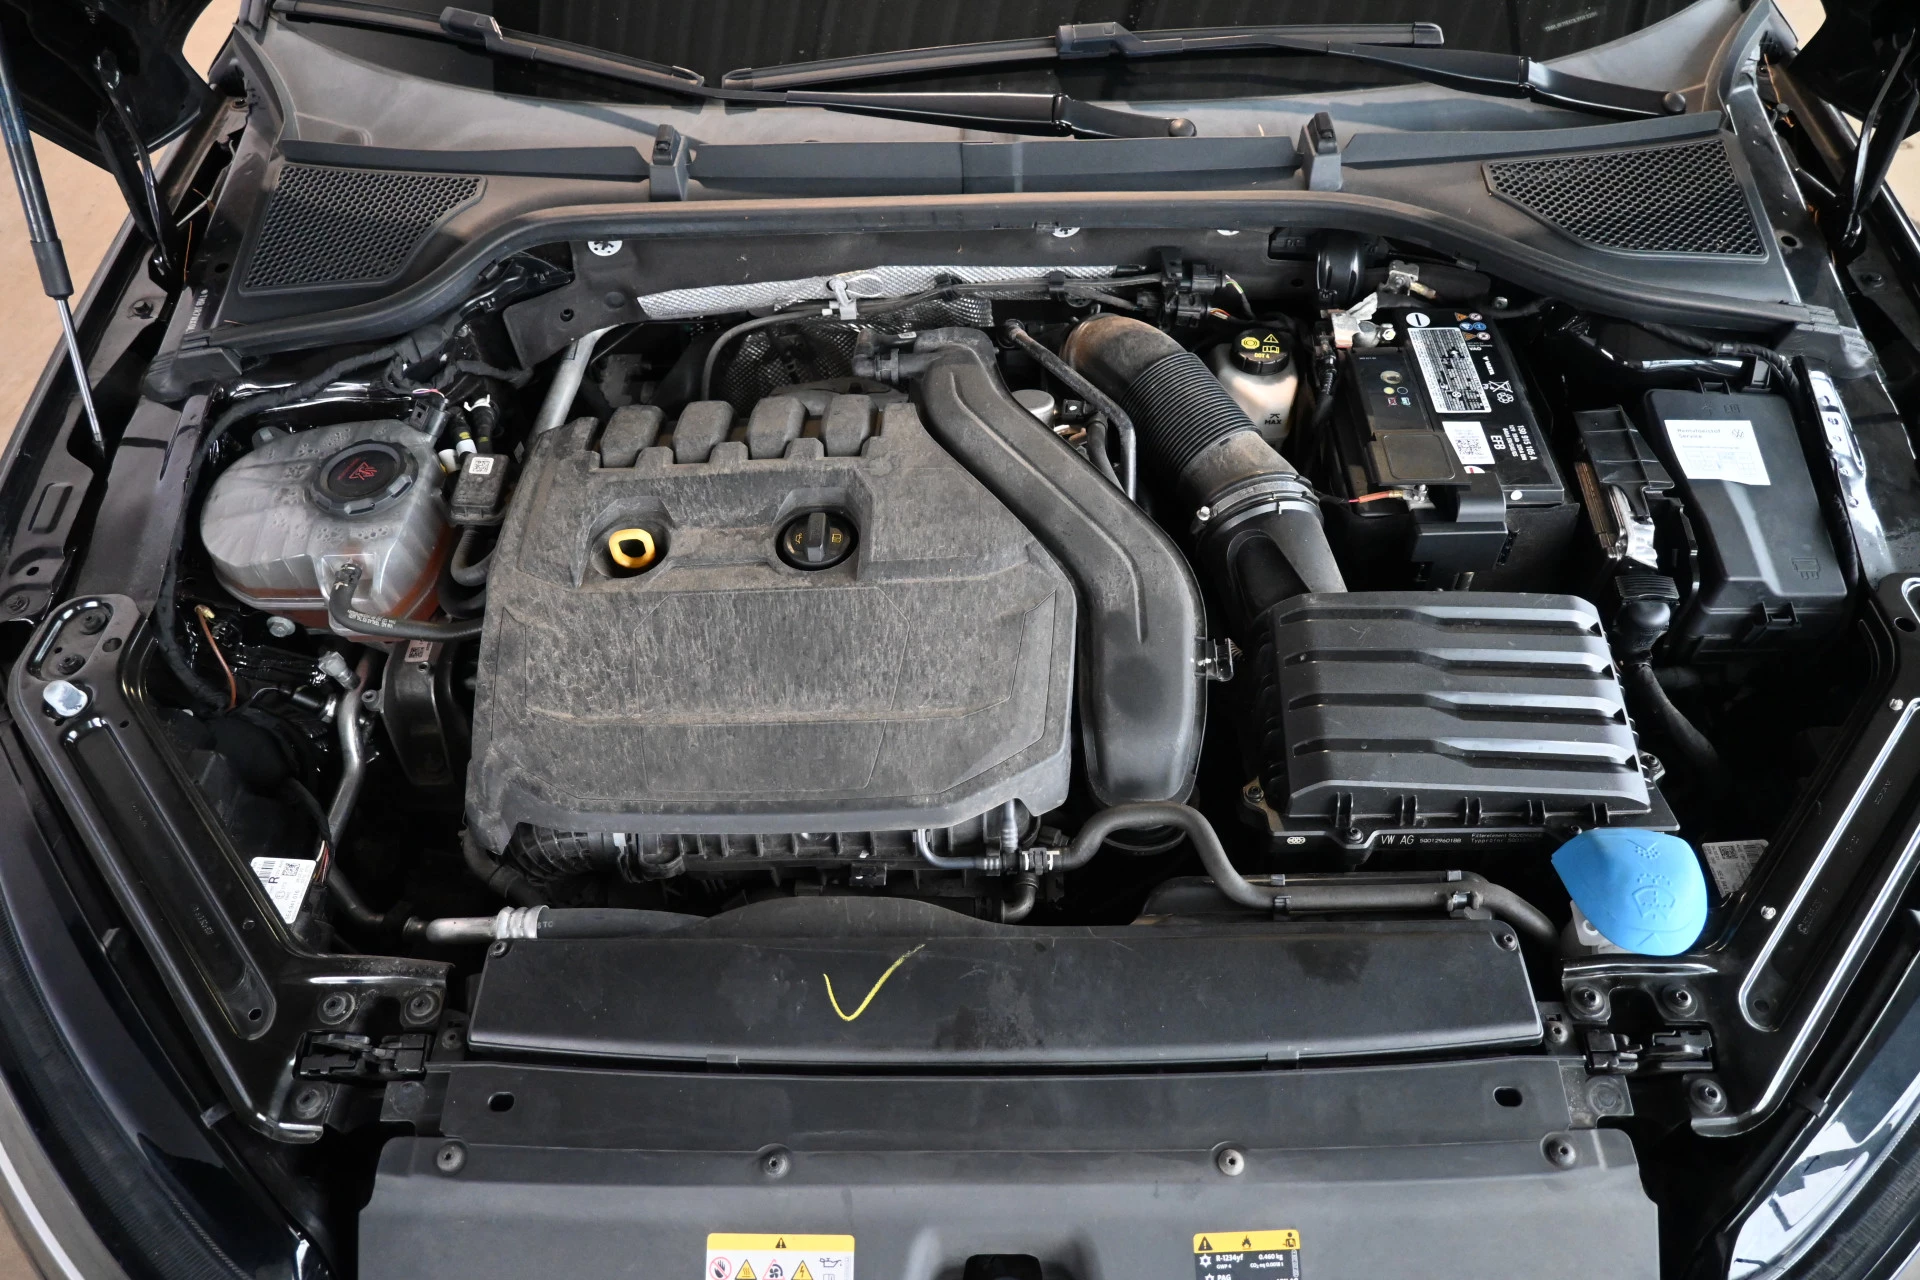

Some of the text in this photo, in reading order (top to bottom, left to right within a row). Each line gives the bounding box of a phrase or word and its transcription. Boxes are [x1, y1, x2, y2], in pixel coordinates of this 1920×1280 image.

[1490, 435, 1506, 450] EFB
[1381, 835, 1395, 845] VW
[1400, 835, 1415, 845] AG
[1215, 1253, 1244, 1263] R-1234yf
[1275, 1253, 1284, 1261] kg
